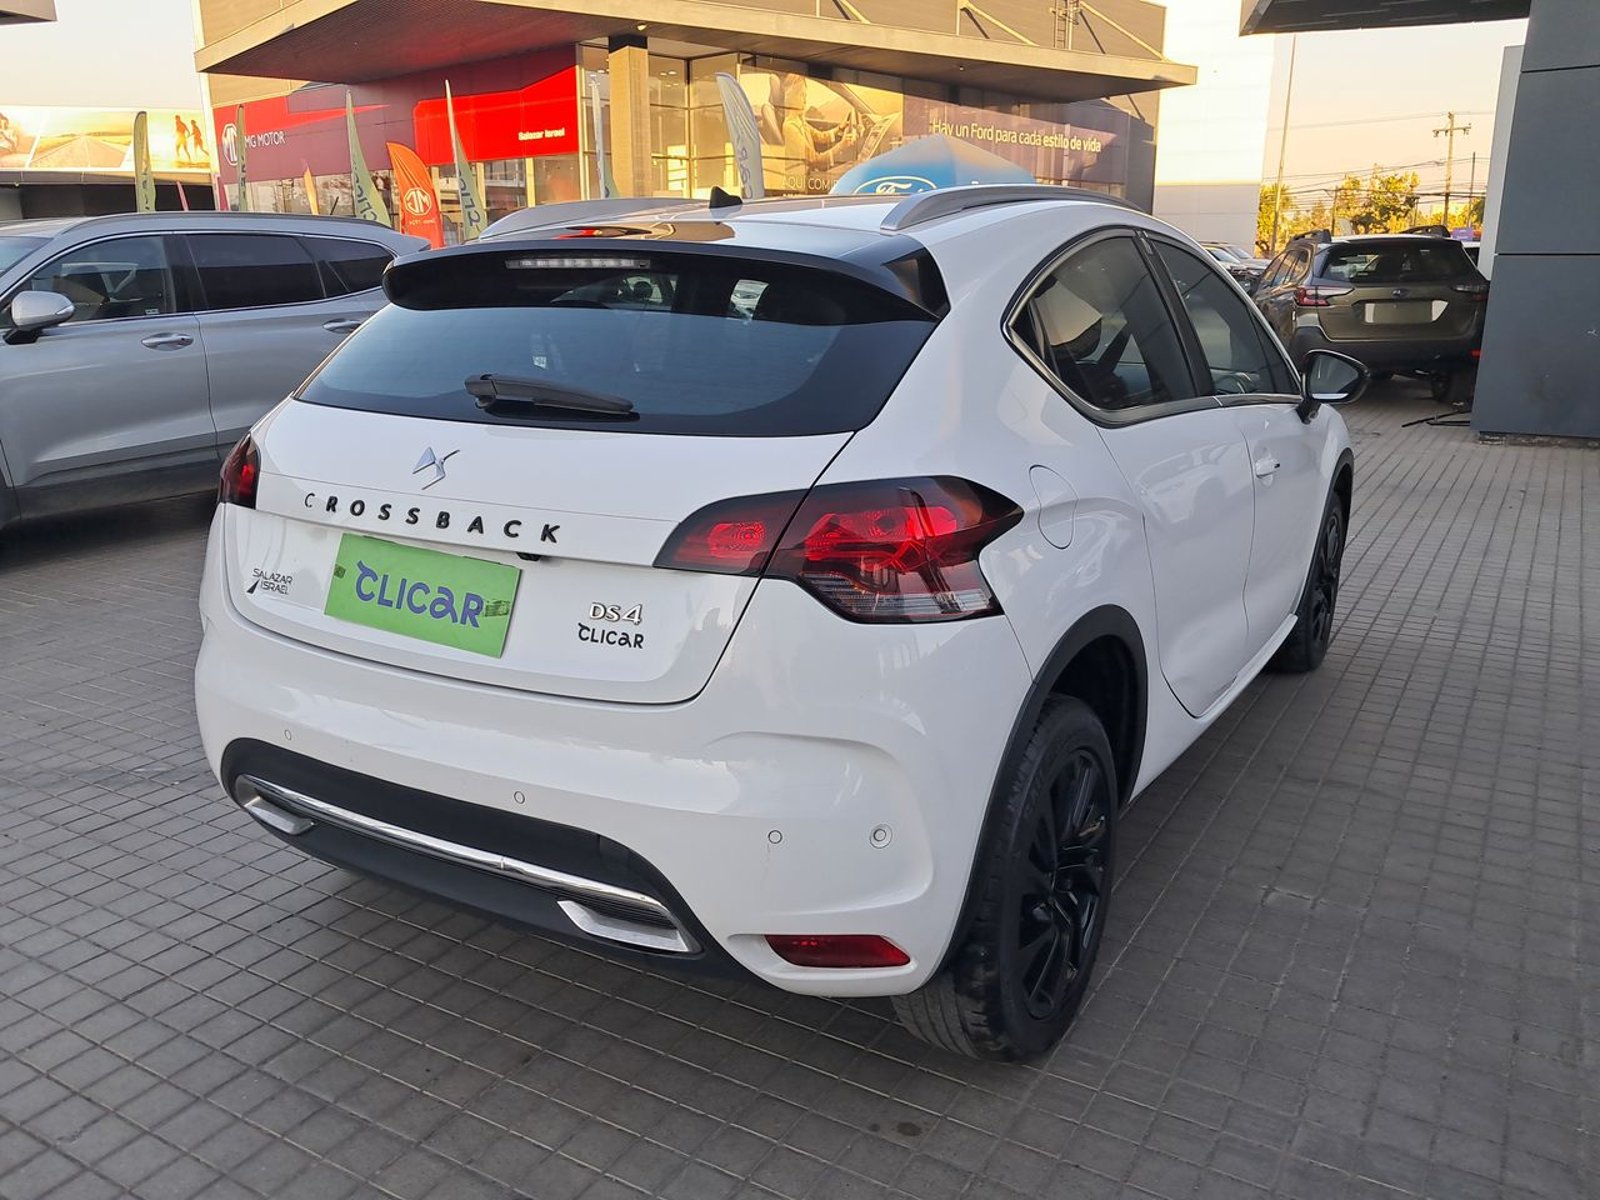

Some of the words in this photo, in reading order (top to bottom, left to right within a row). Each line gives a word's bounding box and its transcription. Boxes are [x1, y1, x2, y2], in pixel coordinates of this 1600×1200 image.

[257, 130, 286, 147] MOTOR
[932, 118, 954, 136] Hay
[955, 123, 969, 138] un
[970, 122, 994, 141] Ford
[995, 129, 1017, 144] para
[1018, 130, 1042, 146] cada
[1042, 133, 1069, 149] estilo
[1069, 135, 1082, 151] de
[1082, 138, 1102, 153] vida
[304, 492, 561, 543] CROSSBACK
[252, 568, 293, 584] SALAZAR
[260, 580, 289, 595] ISRAEL
